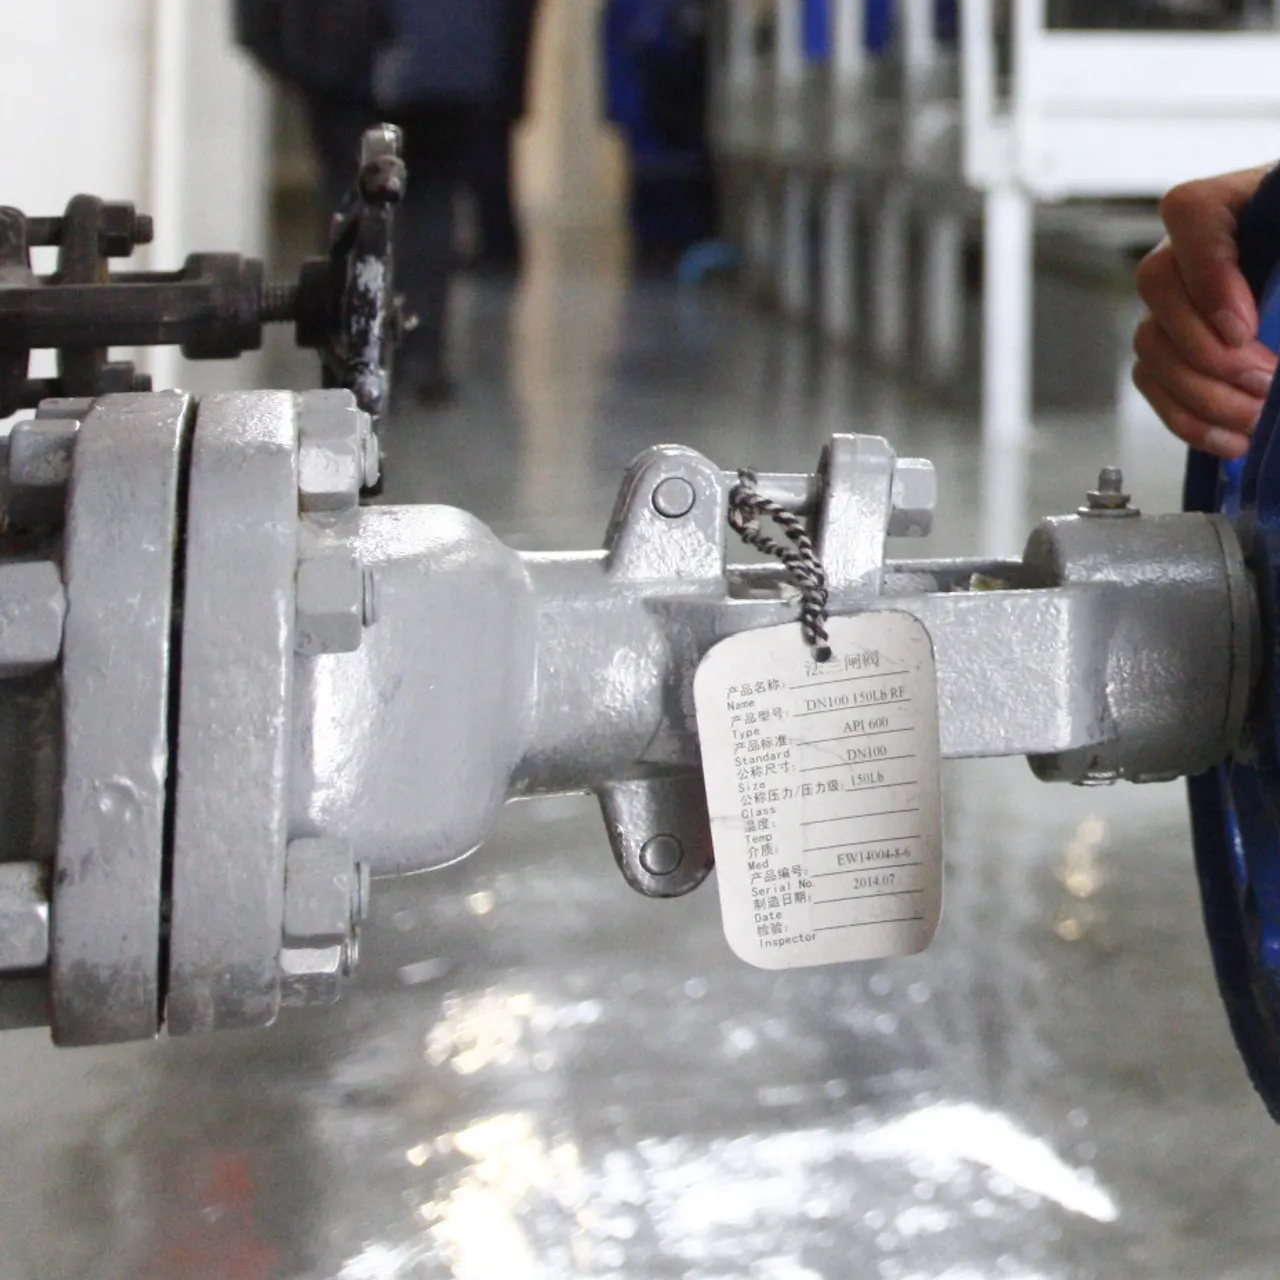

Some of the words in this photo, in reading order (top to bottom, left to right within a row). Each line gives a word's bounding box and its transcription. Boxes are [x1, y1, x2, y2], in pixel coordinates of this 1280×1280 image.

[727, 700, 756, 711] Name
[806, 694, 849, 711] DN100
[852, 688, 887, 705] 150Lb
[843, 719, 865, 734] API
[868, 717, 889, 730] 600
[732, 728, 760, 740] Type
[734, 749, 790, 767] Standard
[846, 744, 887, 761] DN100
[851, 771, 885, 787] 150Lb
[738, 782, 766, 793] Size
[741, 806, 776, 819] Class
[745, 833, 772, 845] Temp
[747, 858, 769, 870] Med
[751, 881, 791, 897] Serial
[798, 878, 815, 889] No.
[853, 873, 896, 890] 2014.07
[754, 911, 782, 923] Date
[760, 933, 817, 949] Inspector
